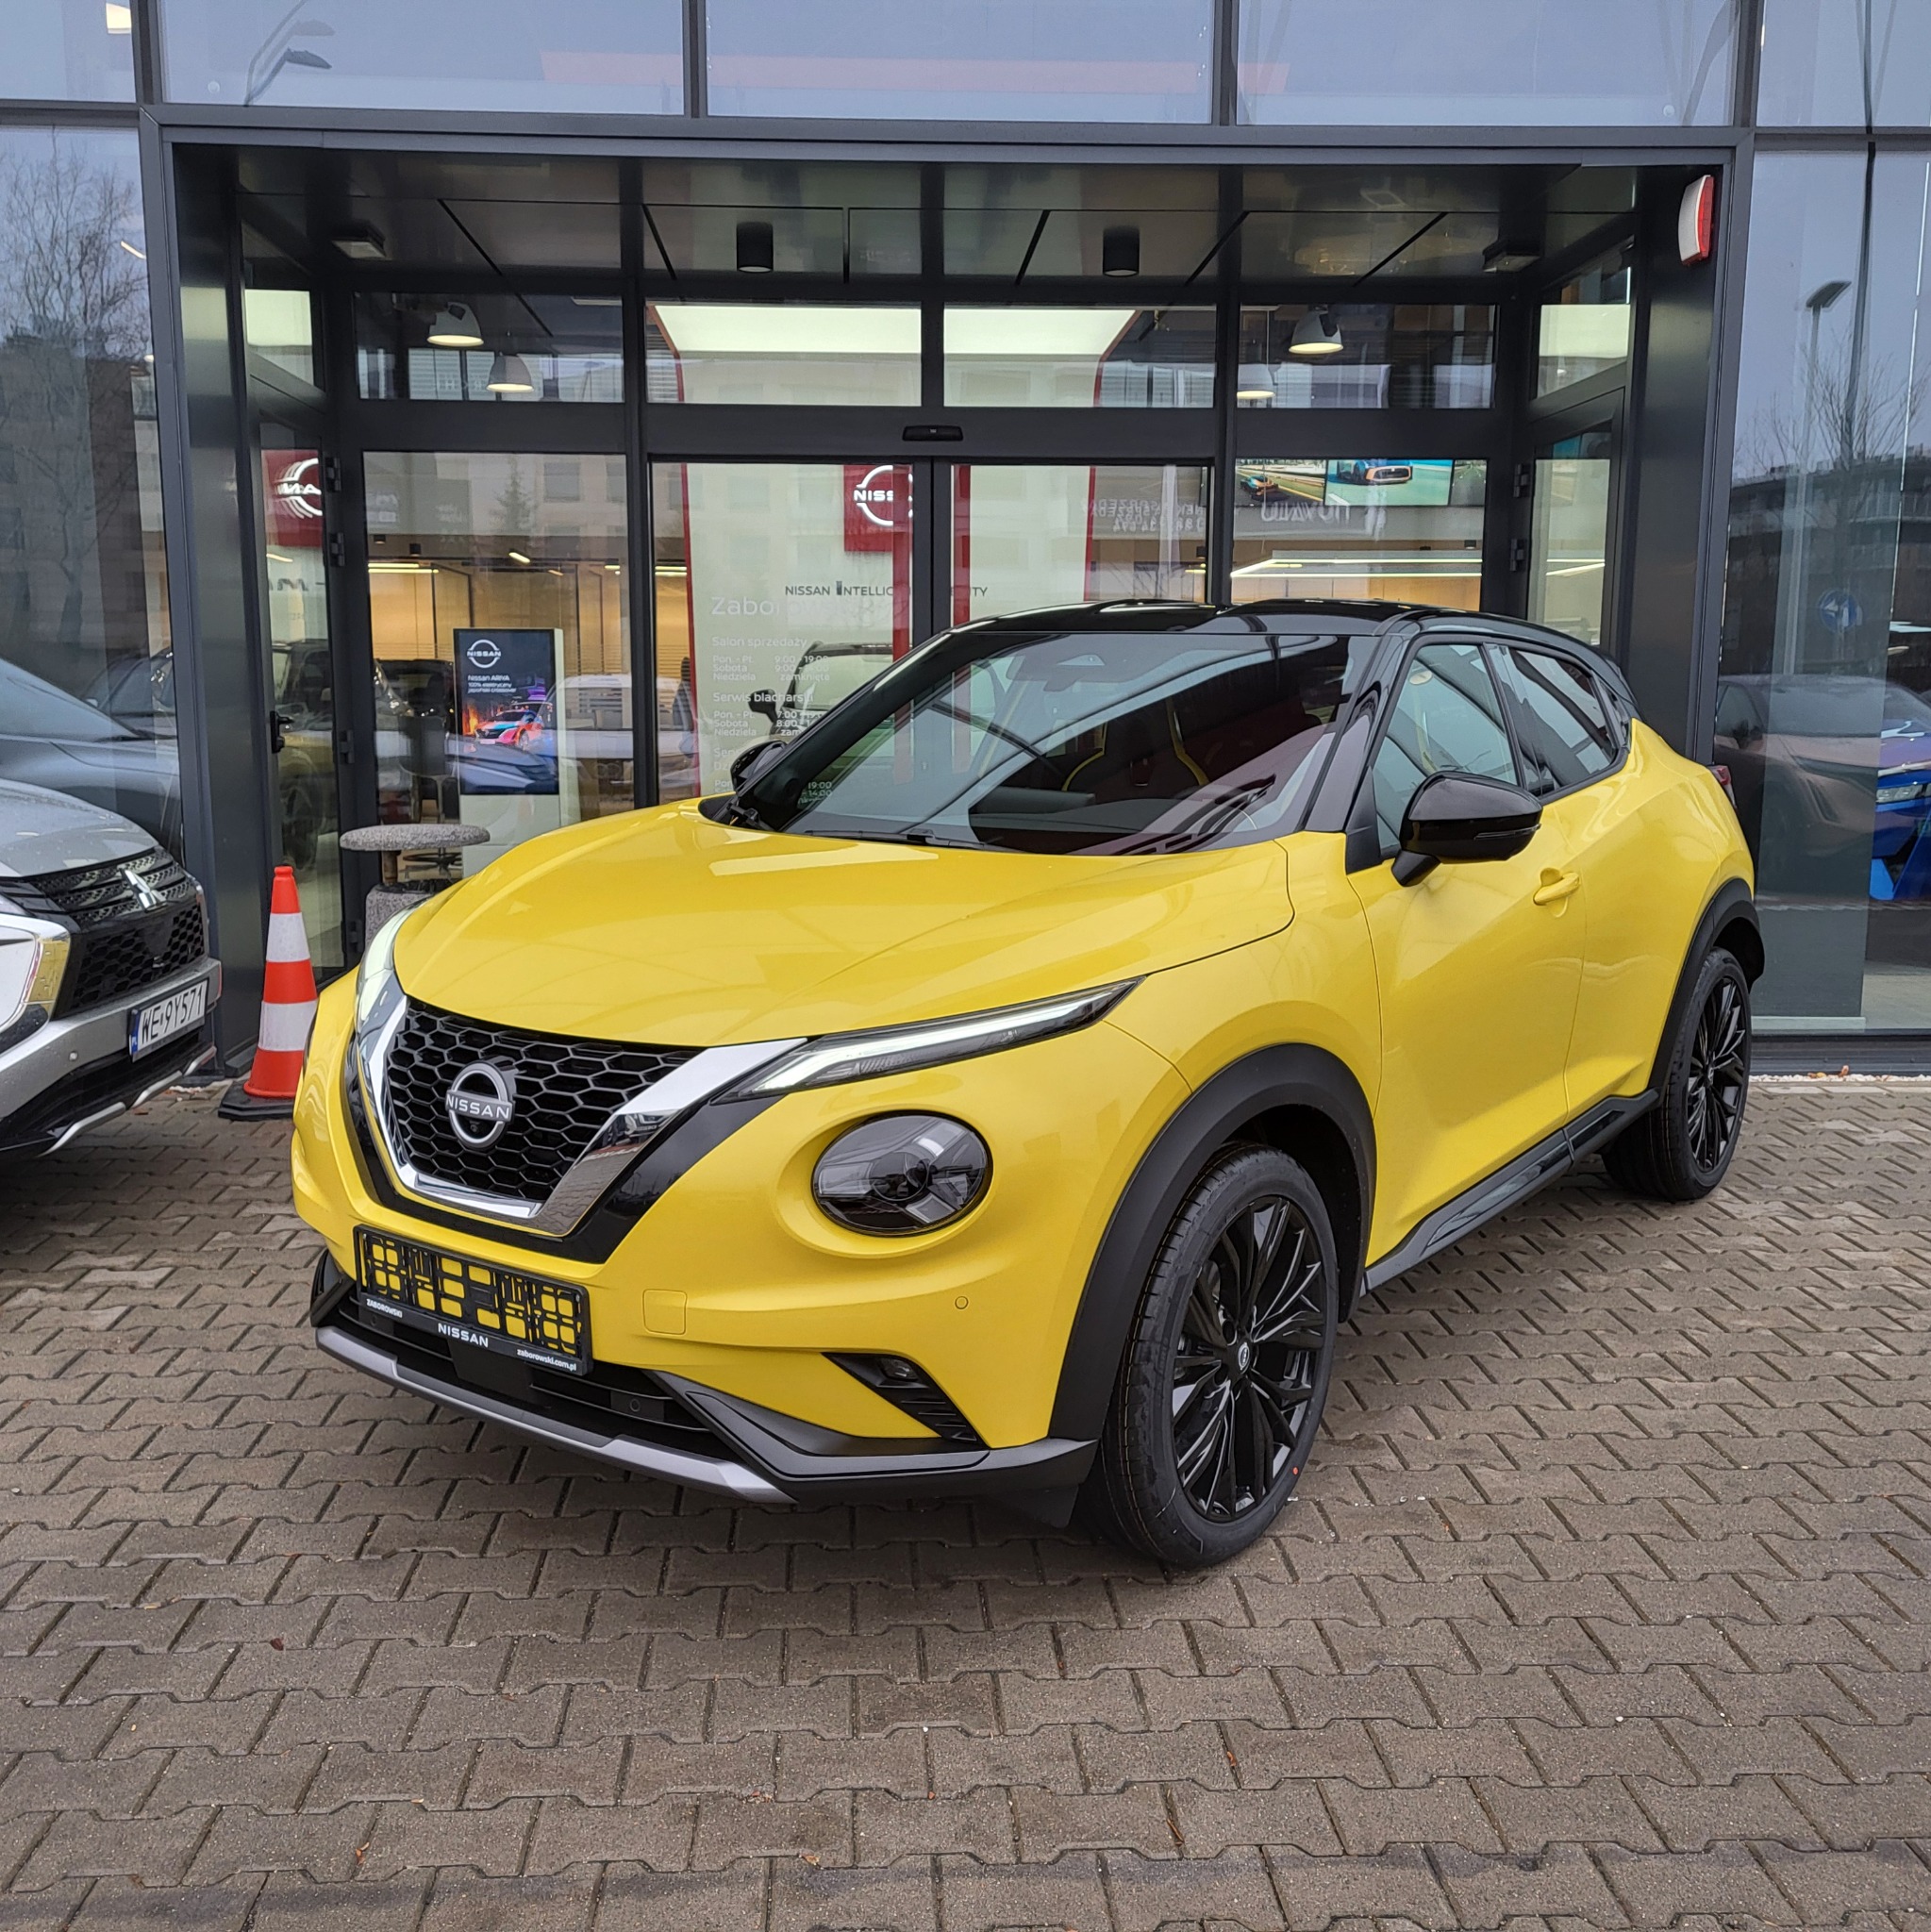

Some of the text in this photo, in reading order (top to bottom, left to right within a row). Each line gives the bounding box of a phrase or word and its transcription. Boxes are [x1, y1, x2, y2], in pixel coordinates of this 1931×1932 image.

[854, 490, 894, 502] NISS
[785, 586, 830, 596] NISSAN
[712, 637, 807, 649] Salon sprzedaży
[713, 663, 748, 673] Sobota
[713, 673, 756, 681] Niedziela
[713, 692, 751, 702] Serwis
[714, 719, 748, 727] Sobota
[714, 727, 757, 736] Niedziela
[141, 1004, 161, 1043] WE
[163, 984, 203, 1034] 9Y571
[446, 1093, 509, 1120] NISSAN
[366, 1298, 403, 1319] ZABOROWSKI
[438, 1323, 489, 1348] NISSAN
[517, 1348, 577, 1372] zaborowski.com.pl
